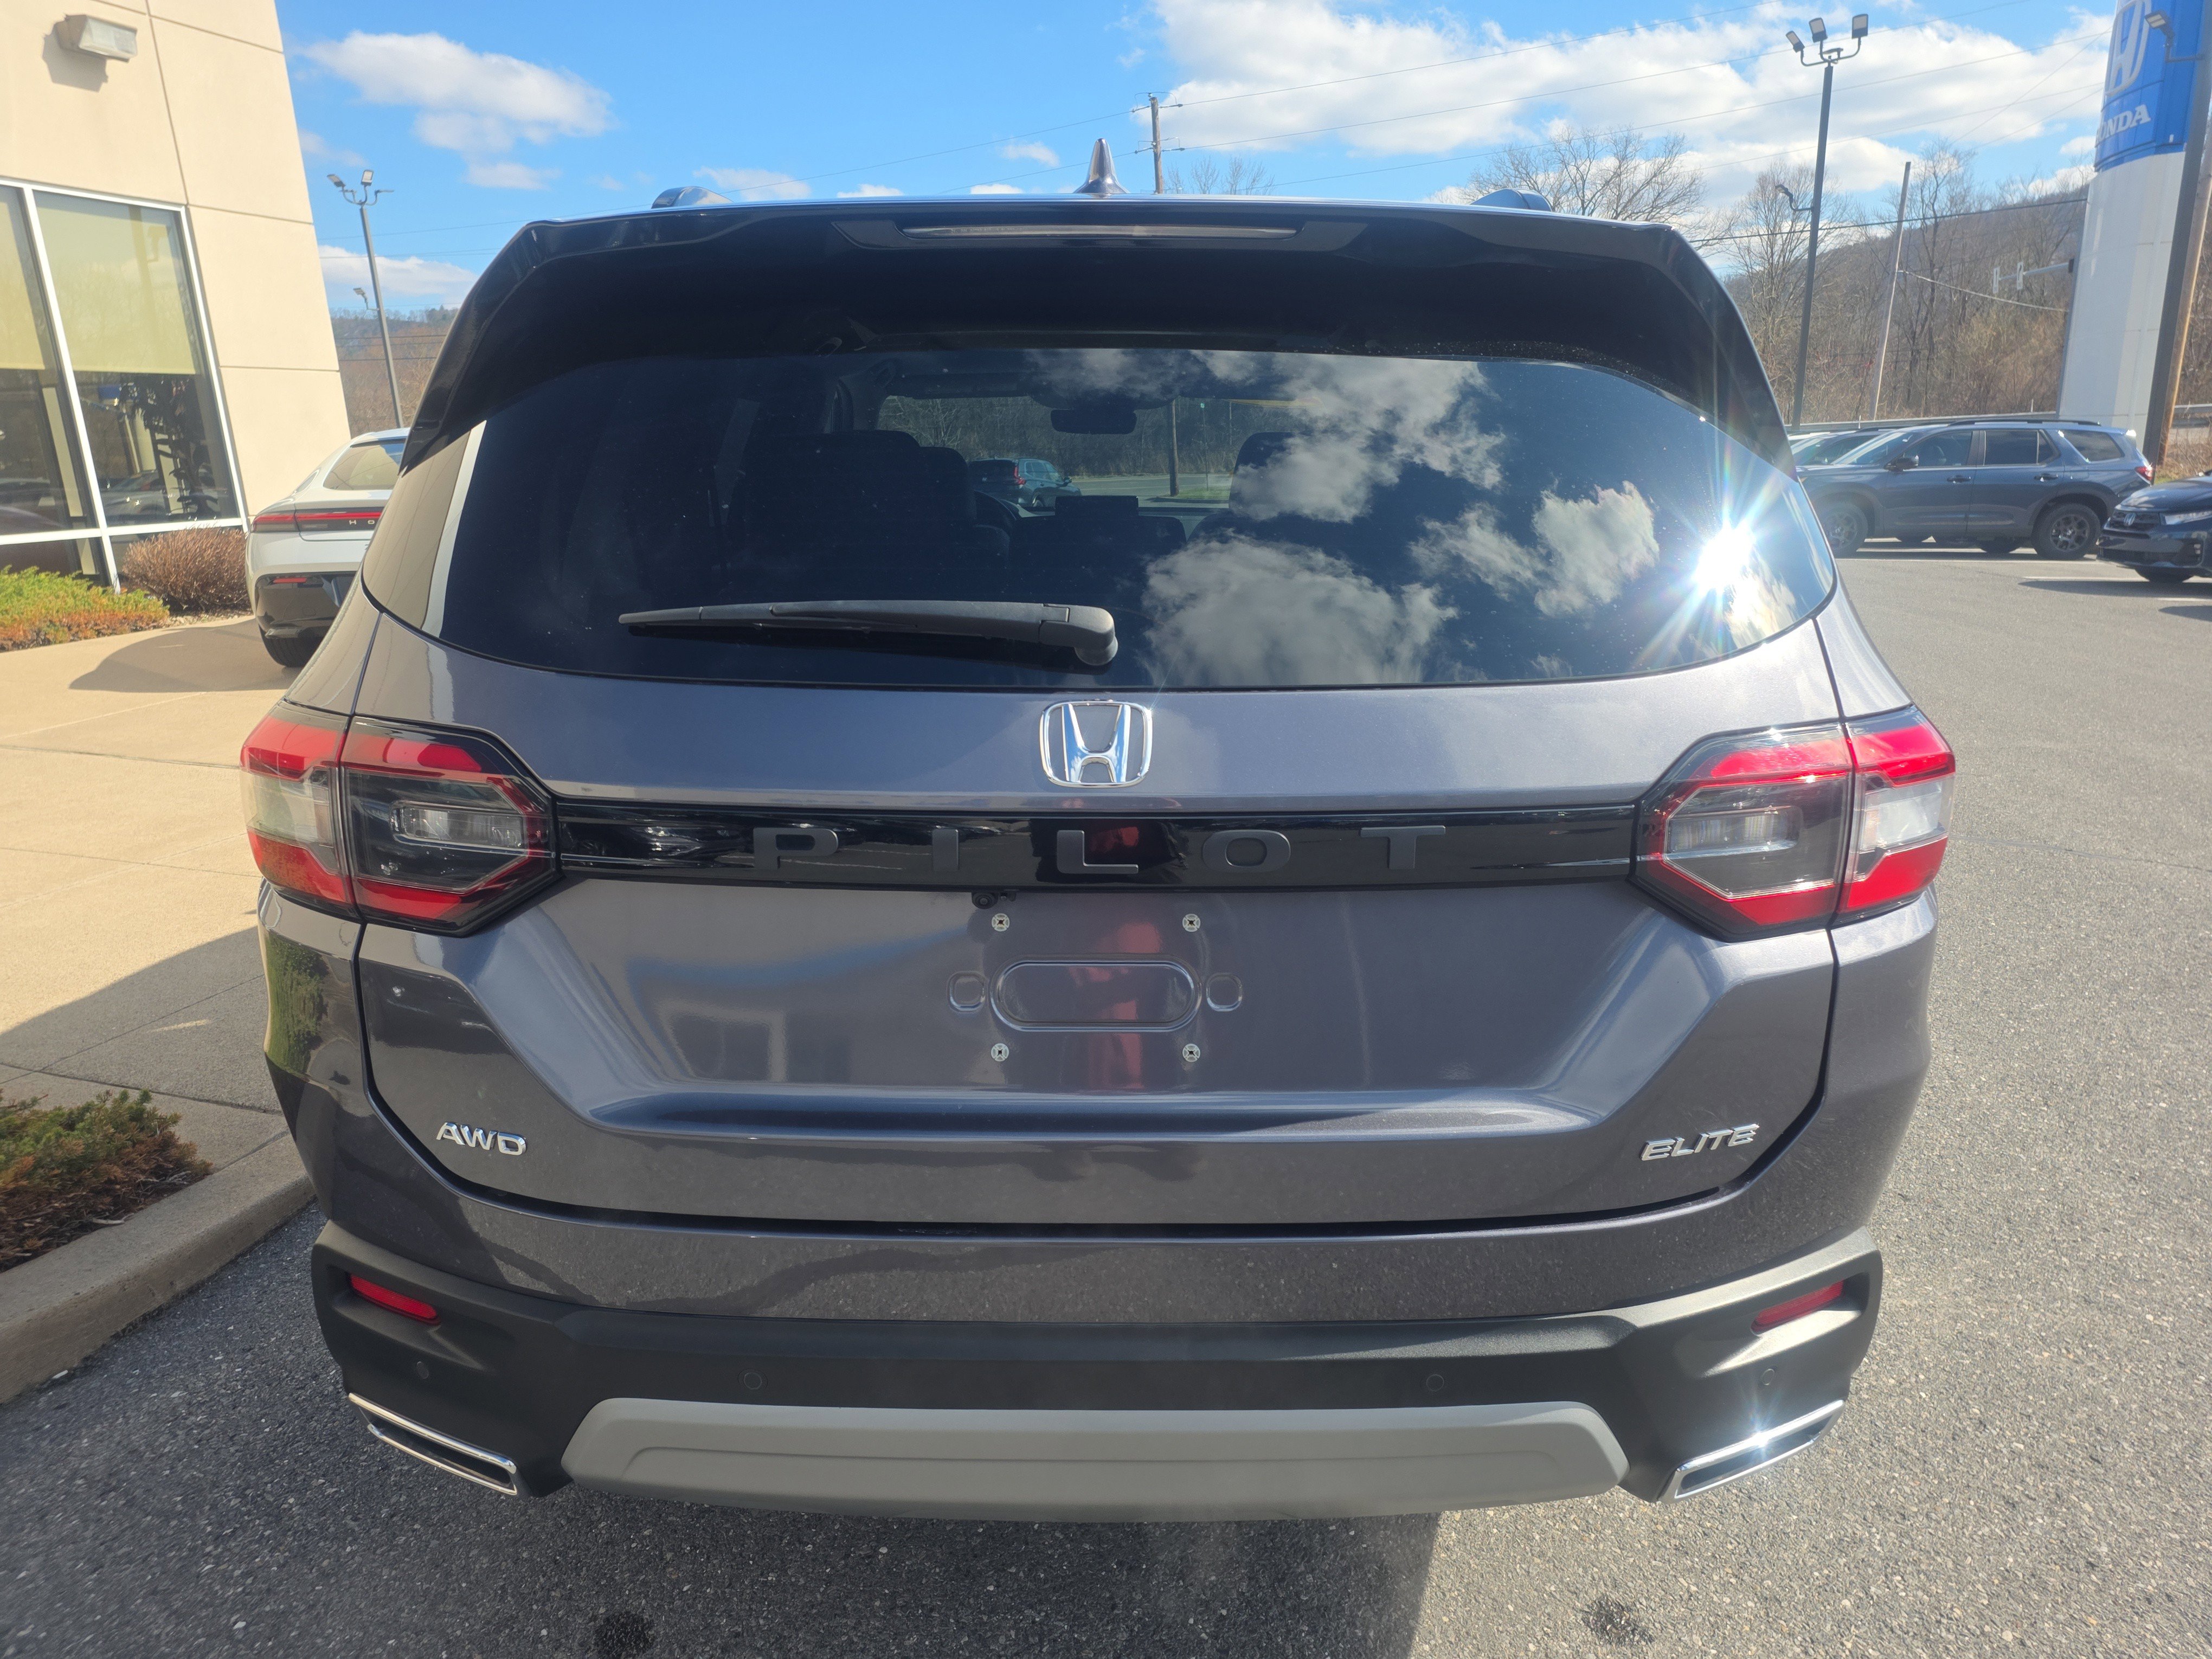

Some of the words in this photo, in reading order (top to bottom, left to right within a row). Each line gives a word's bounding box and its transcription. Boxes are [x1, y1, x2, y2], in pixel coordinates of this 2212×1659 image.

[2096, 104, 2151, 143] ONDA
[754, 825, 1446, 874] PILOT
[436, 1122, 526, 1156] AWD
[1639, 1123, 1760, 1161] ELITE
